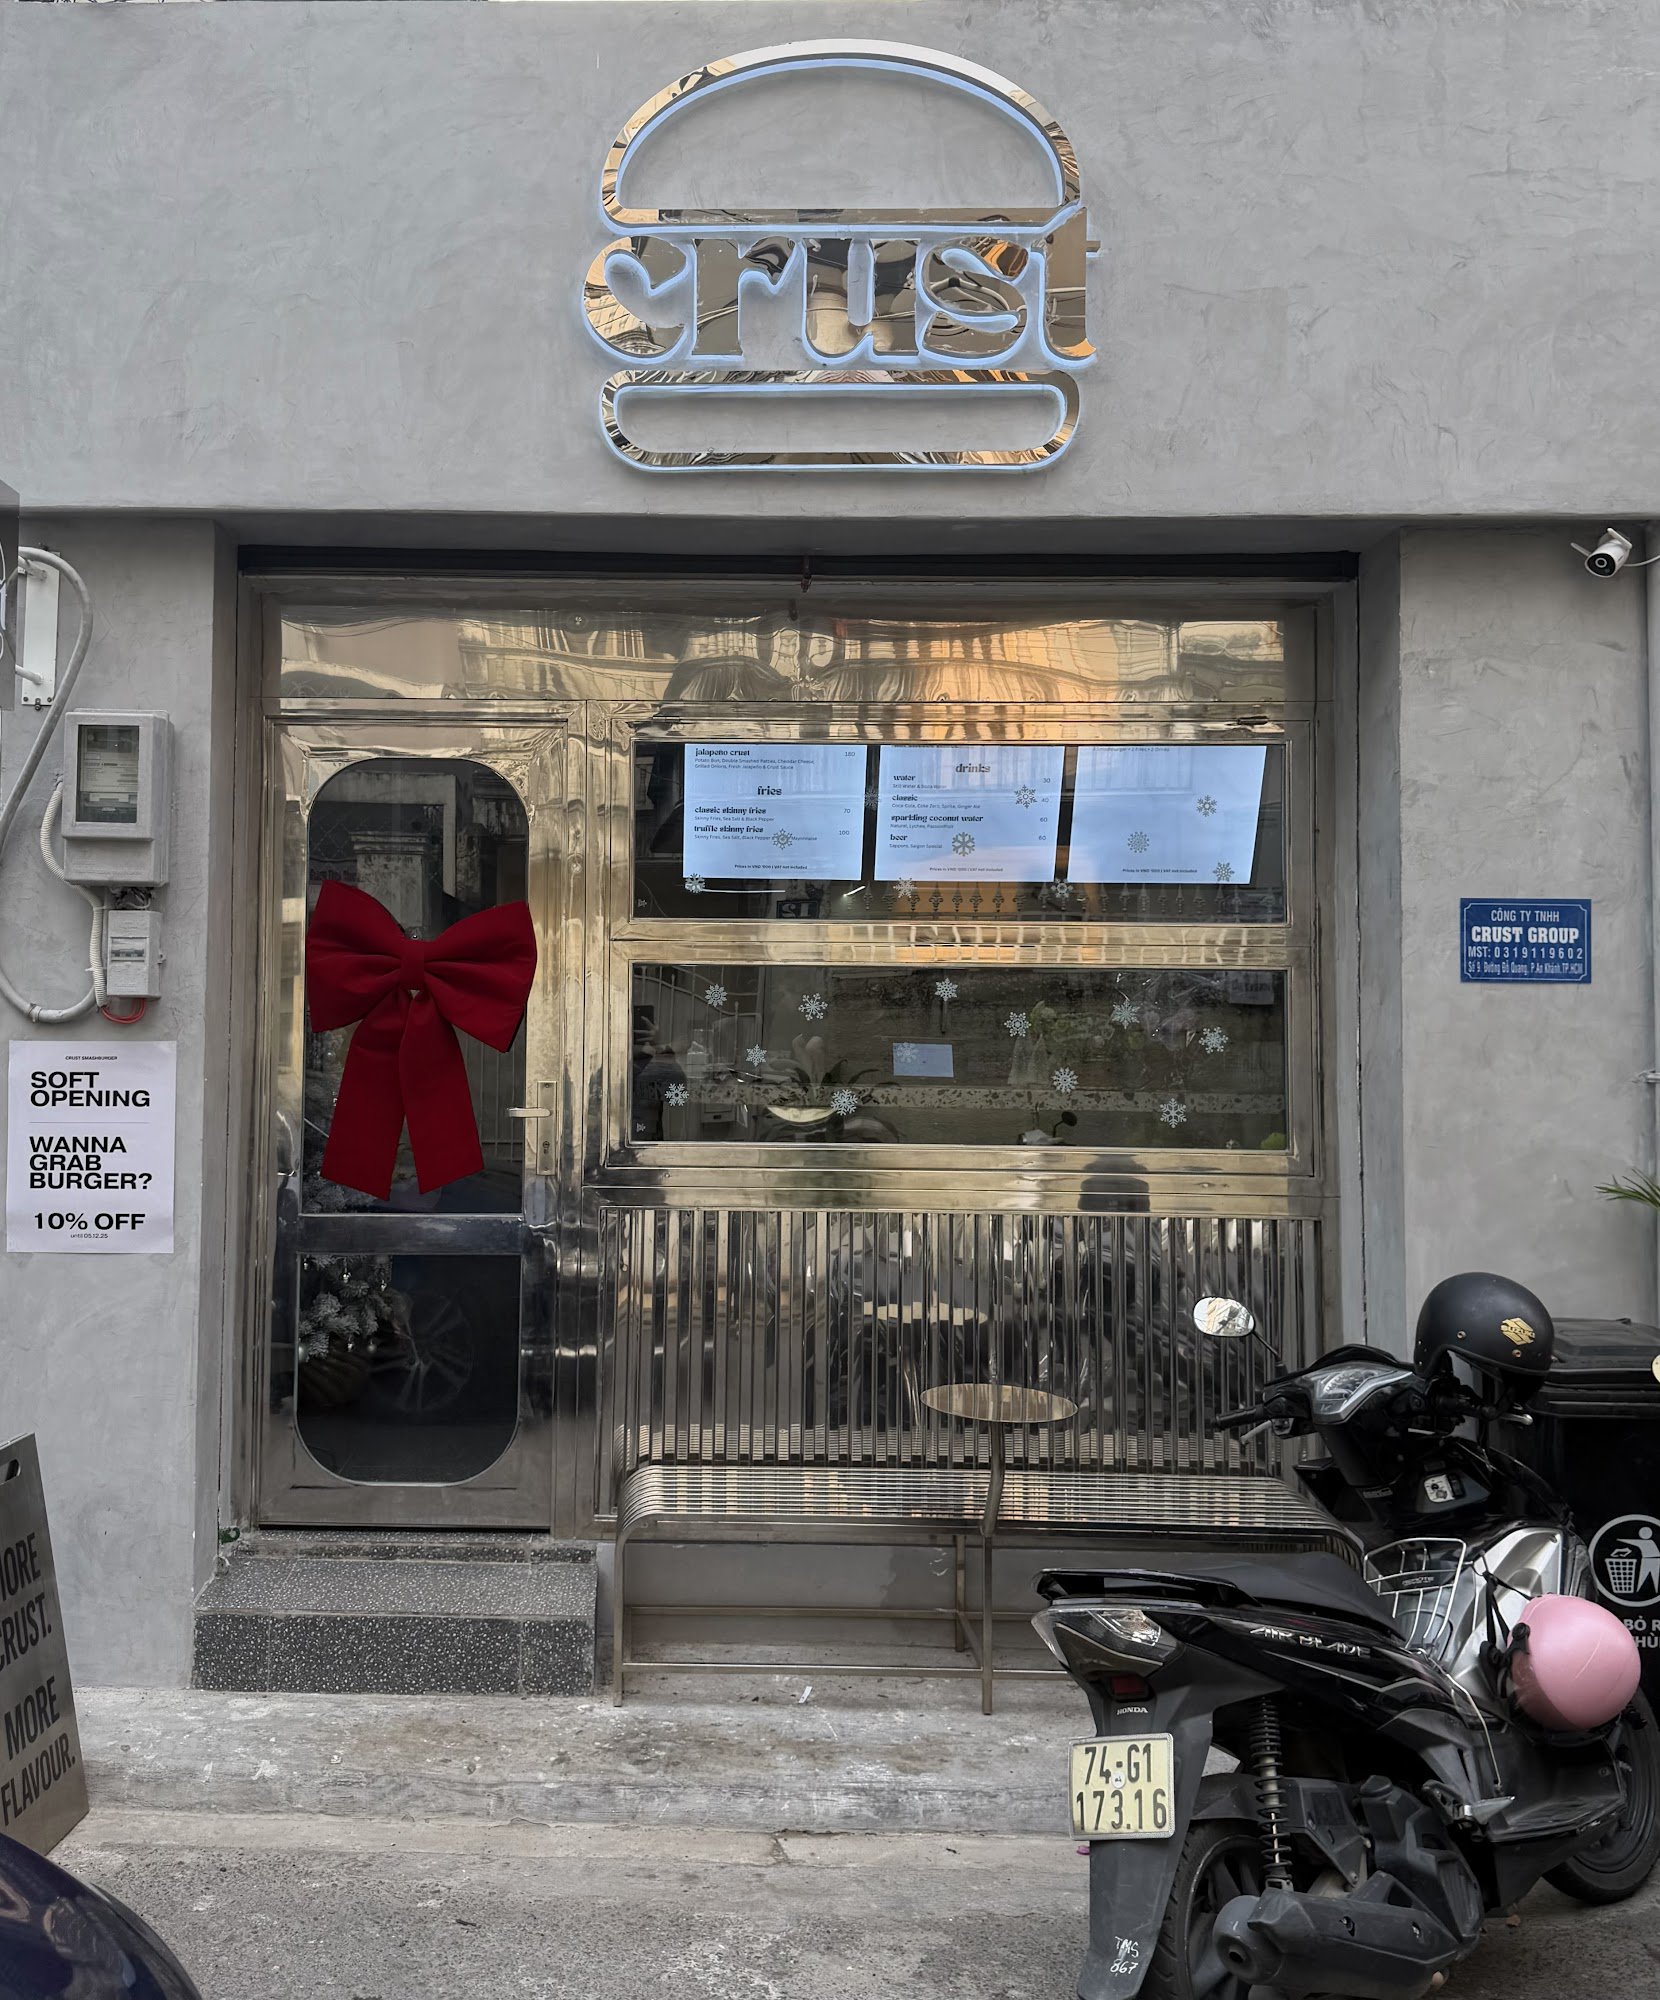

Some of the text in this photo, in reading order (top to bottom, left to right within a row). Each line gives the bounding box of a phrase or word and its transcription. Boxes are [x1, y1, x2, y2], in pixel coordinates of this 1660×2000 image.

[583, 206, 1103, 365] crust
[730, 748, 751, 756] crust
[955, 763, 991, 773] drinks
[757, 785, 782, 796] fries
[694, 806, 767, 815] classic skinny fries
[1491, 907, 1560, 922] CÔNG TY TNHH
[1472, 926, 1580, 943] CRUST GROUP
[1468, 946, 1491, 958] MST:
[31, 1071, 99, 1088] SOFT
[30, 1090, 150, 1107] OPENING
[30, 1136, 127, 1153] WANNA
[30, 1154, 102, 1171] GRAB
[30, 1173, 152, 1190] BURGER?
[34, 1212, 145, 1230] 10% OFF
[5, 1676, 60, 1760] MORE
[2, 1732, 76, 1826] FLAVOUR.
[1076, 1788, 1167, 1830] 173.16
[1110, 1958, 1138, 1974] 867
